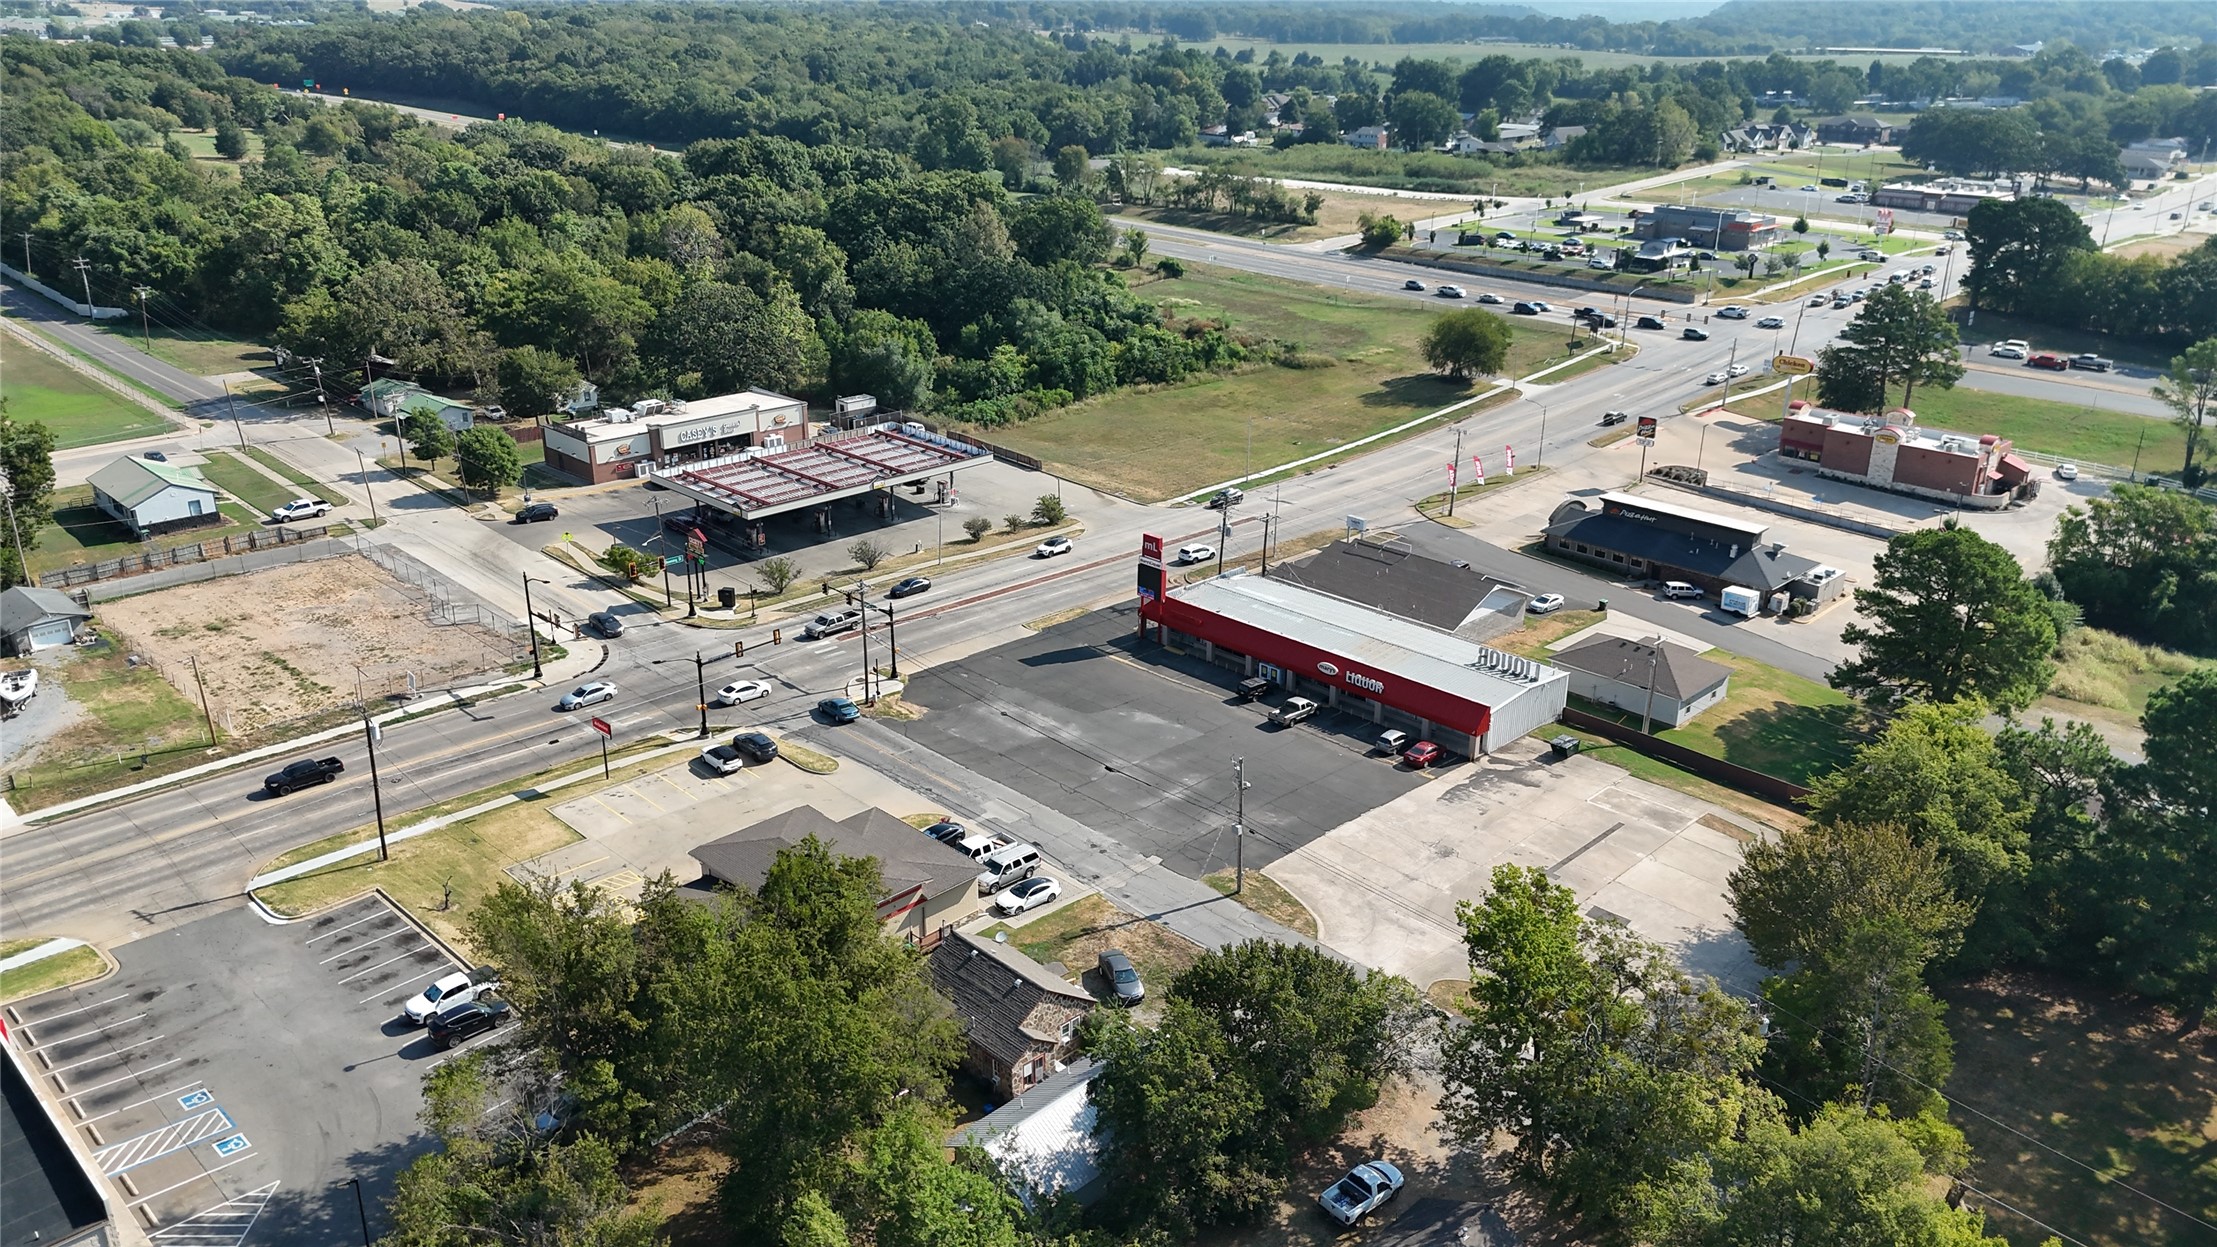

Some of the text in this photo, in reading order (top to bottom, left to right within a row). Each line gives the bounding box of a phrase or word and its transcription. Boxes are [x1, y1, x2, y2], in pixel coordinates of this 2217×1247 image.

[1779, 359, 1806, 369] Chicken
[680, 425, 717, 442] CASEY'S
[1145, 542, 1157, 552] mL
[1346, 671, 1384, 694] LIQUOR
